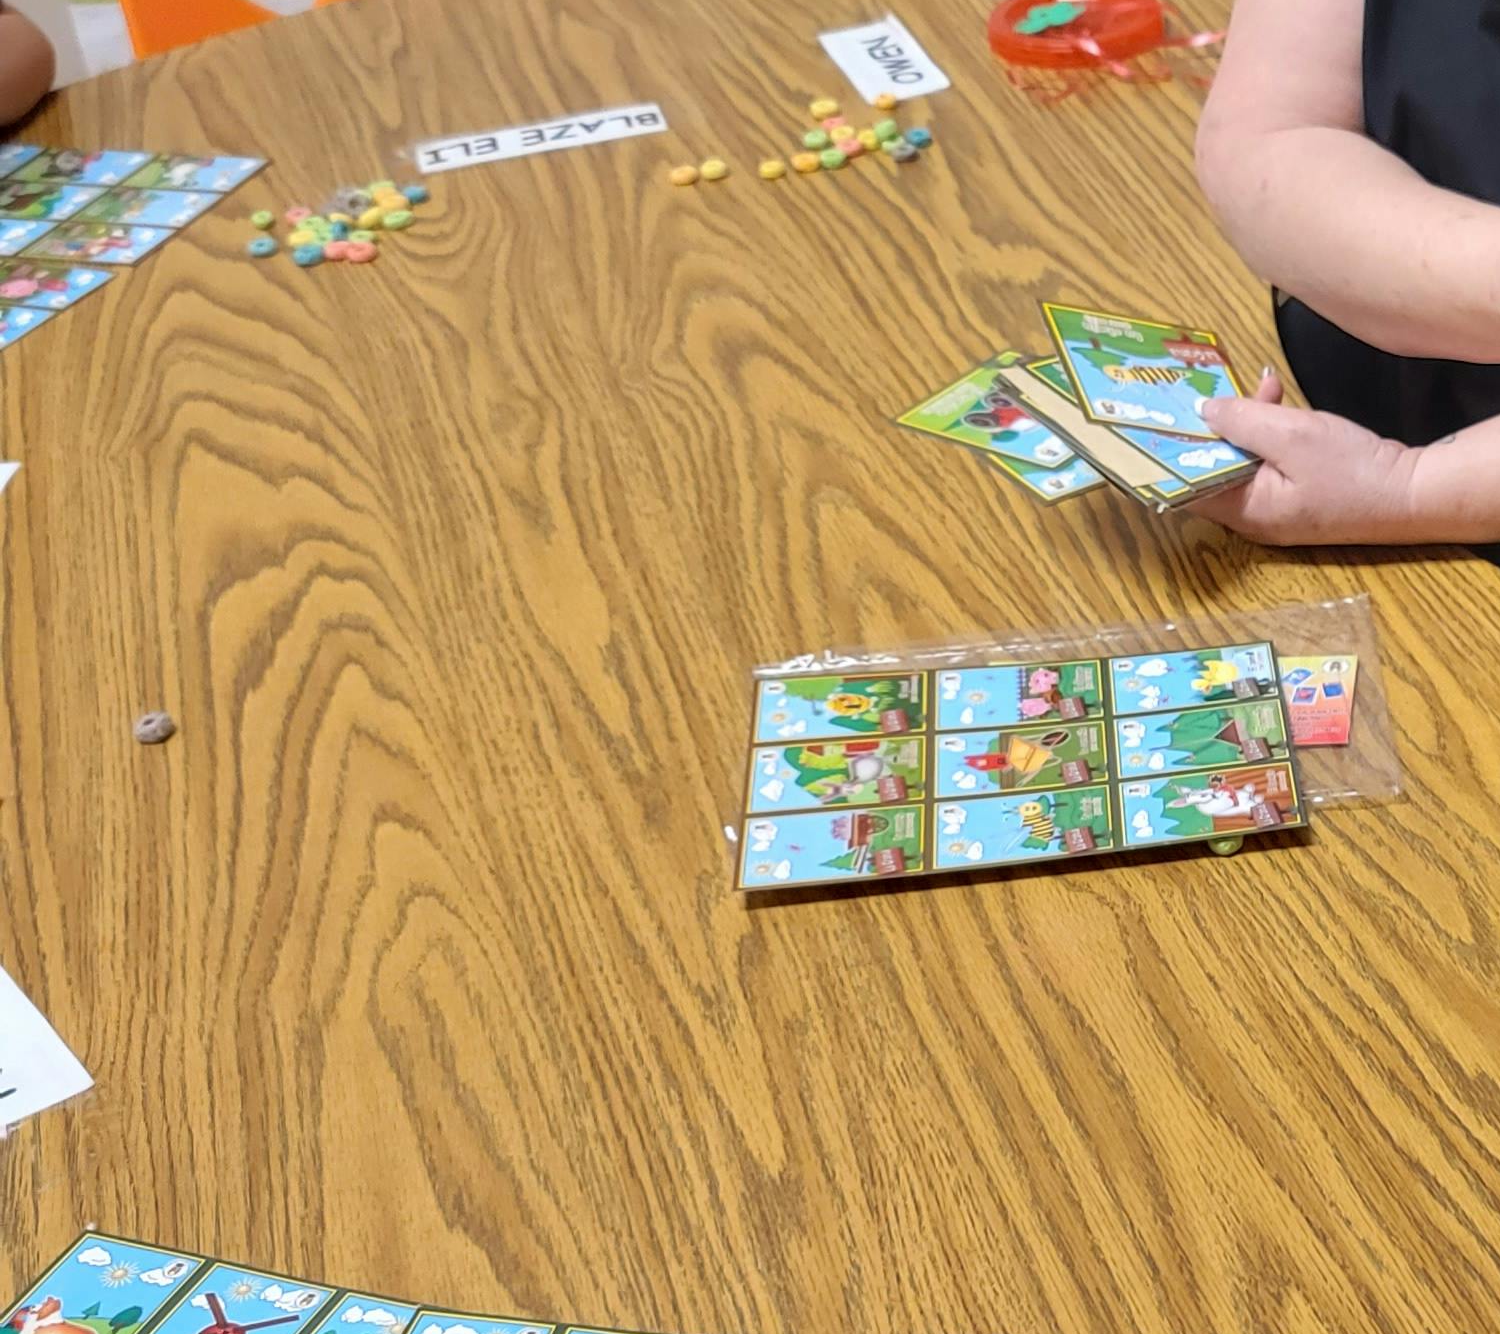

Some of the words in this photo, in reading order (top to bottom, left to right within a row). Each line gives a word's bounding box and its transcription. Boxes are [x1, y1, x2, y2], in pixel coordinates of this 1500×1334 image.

[862, 34, 925, 86] OWEN
[520, 112, 663, 148] BLAZE
[424, 136, 497, 167] ELI
